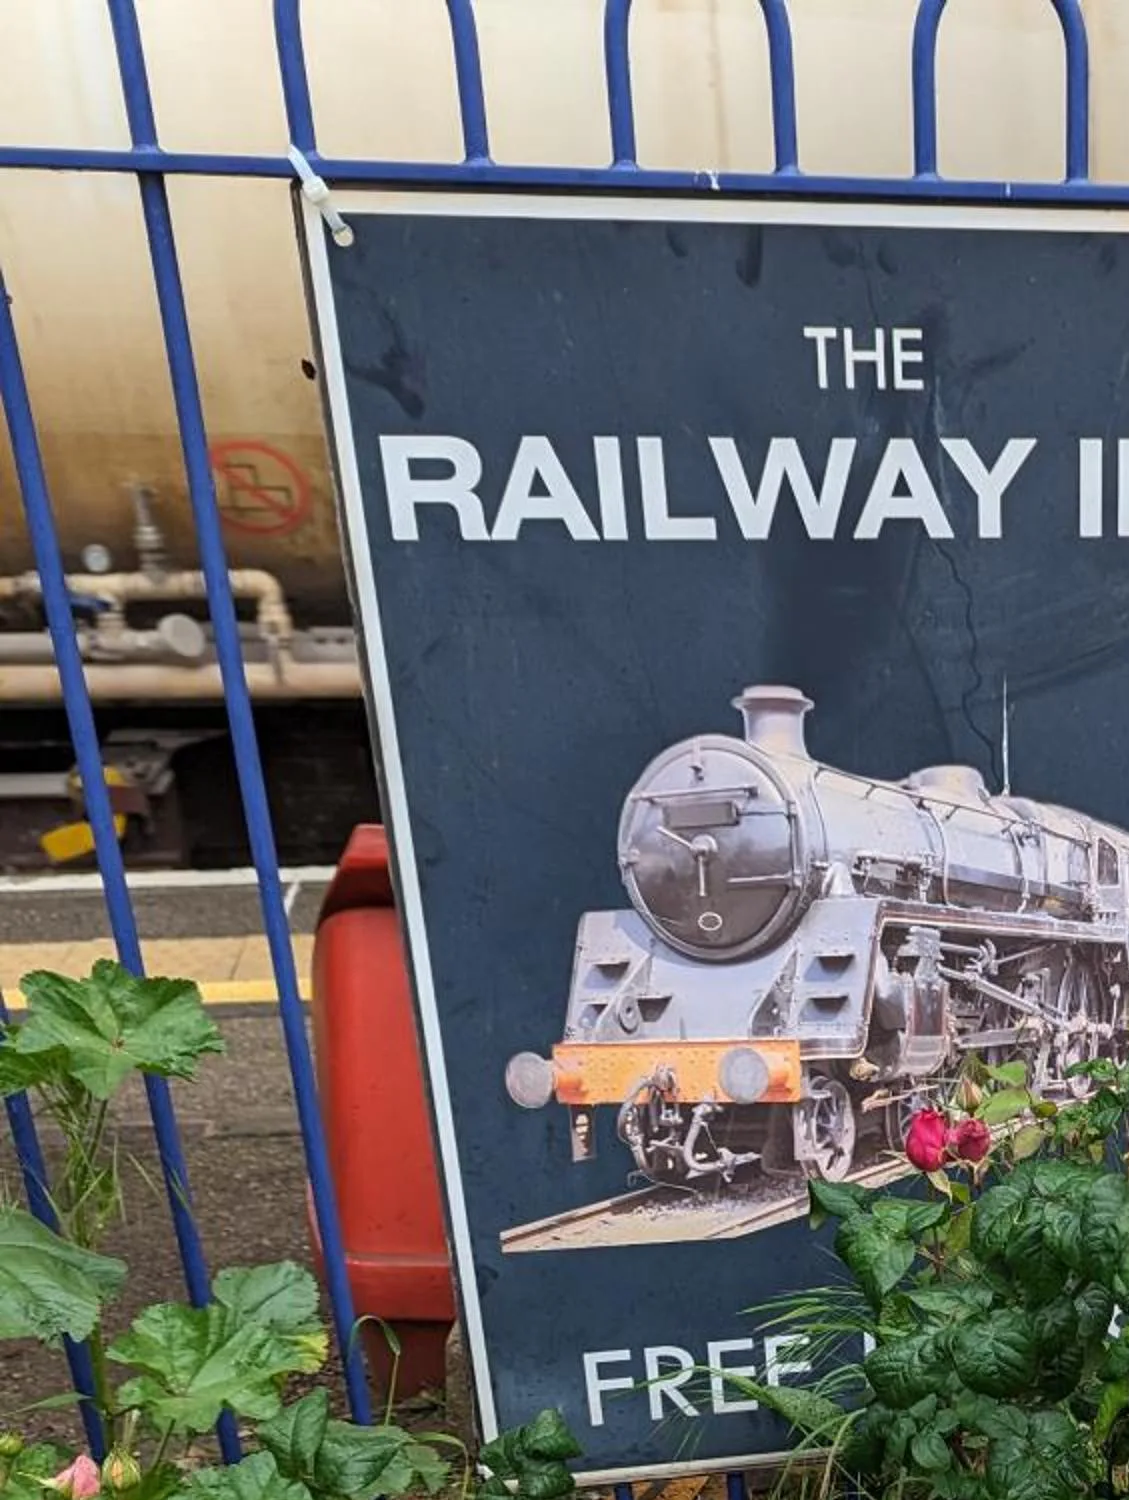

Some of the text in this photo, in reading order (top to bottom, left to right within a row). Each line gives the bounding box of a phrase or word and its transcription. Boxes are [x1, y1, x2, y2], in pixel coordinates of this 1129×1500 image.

[803, 326, 924, 390] THE
[379, 436, 1037, 541] RAILWAY
[583, 1334, 812, 1426] FREE
